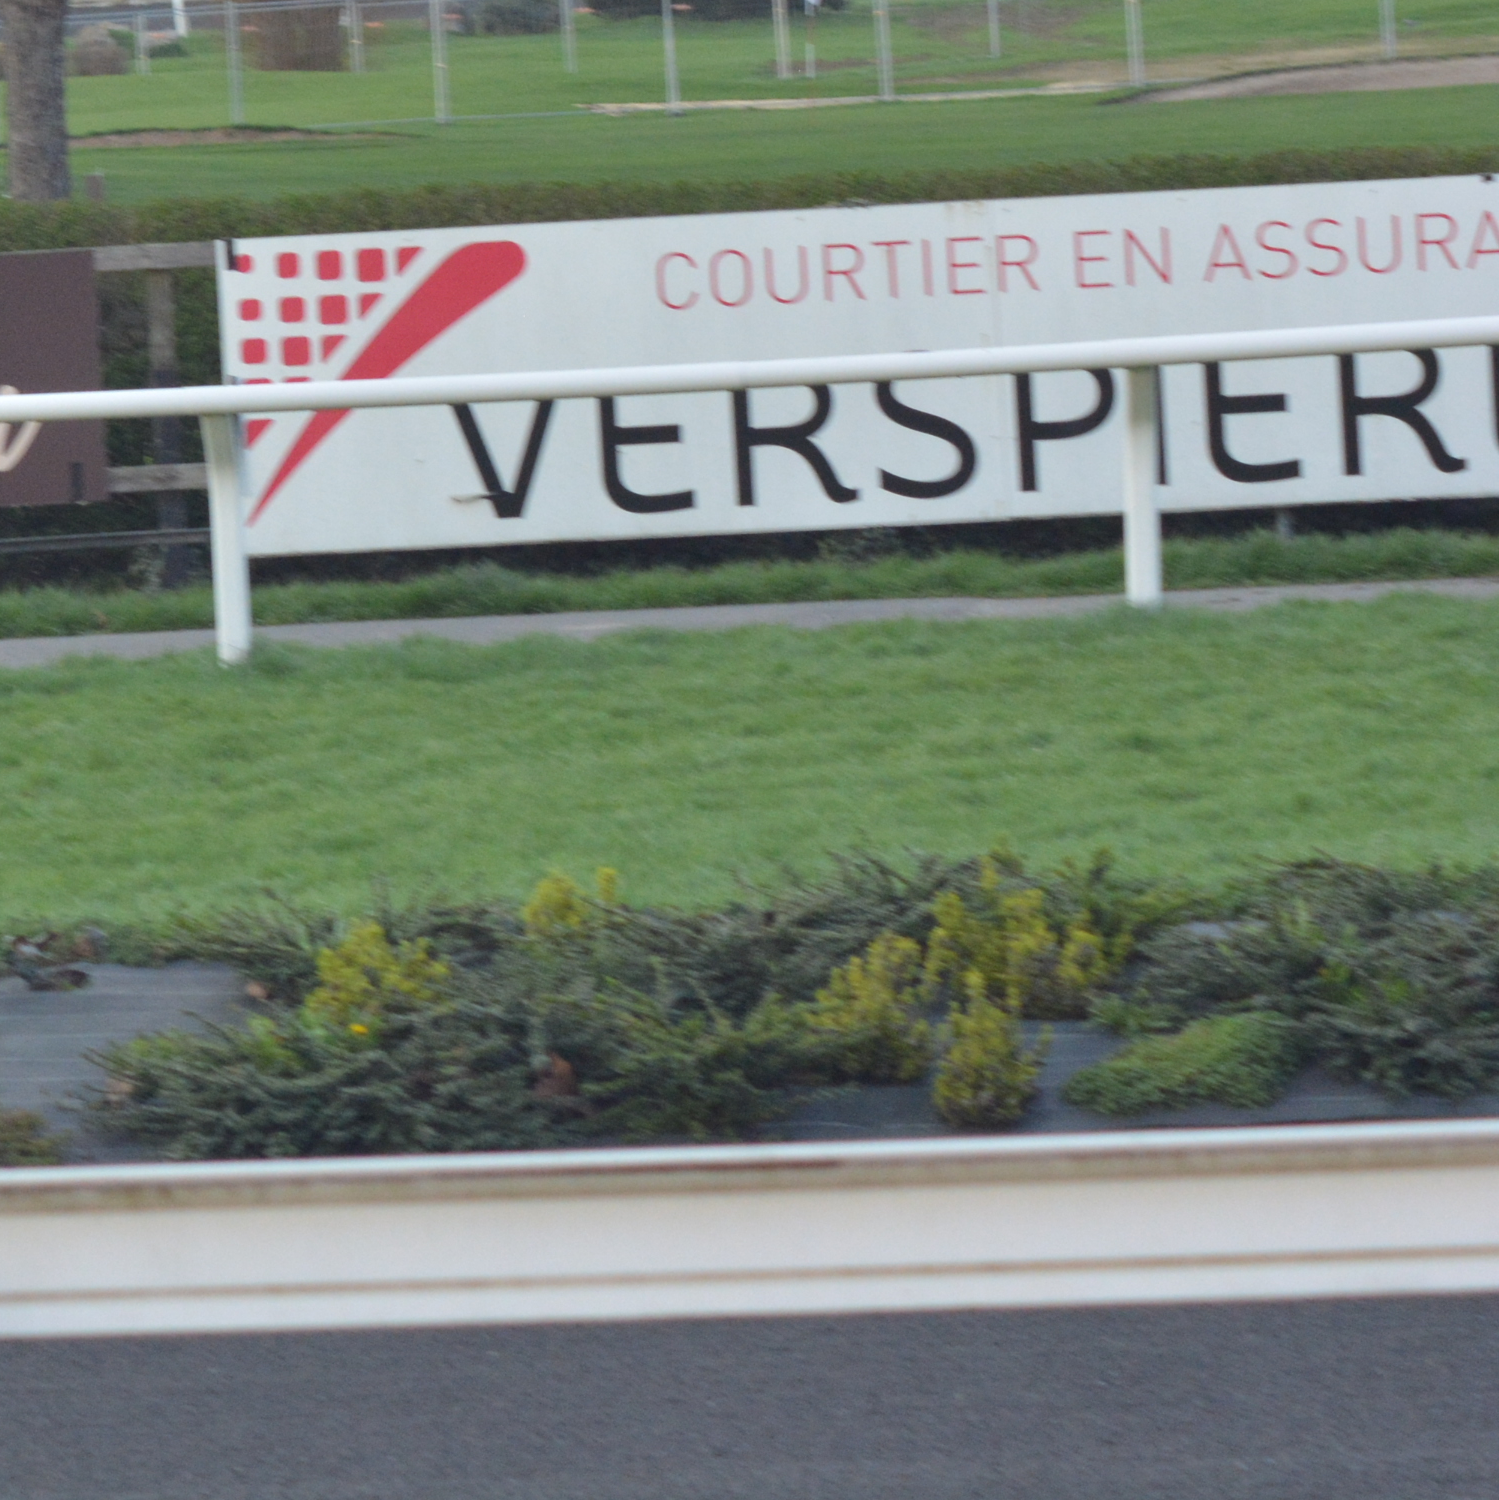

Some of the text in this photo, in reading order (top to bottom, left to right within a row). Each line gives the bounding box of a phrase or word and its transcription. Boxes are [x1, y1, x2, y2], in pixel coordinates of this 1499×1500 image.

[655, 210, 1499, 311] COURTIER EN ASSURA
[449, 338, 1499, 518] VERSPIER
